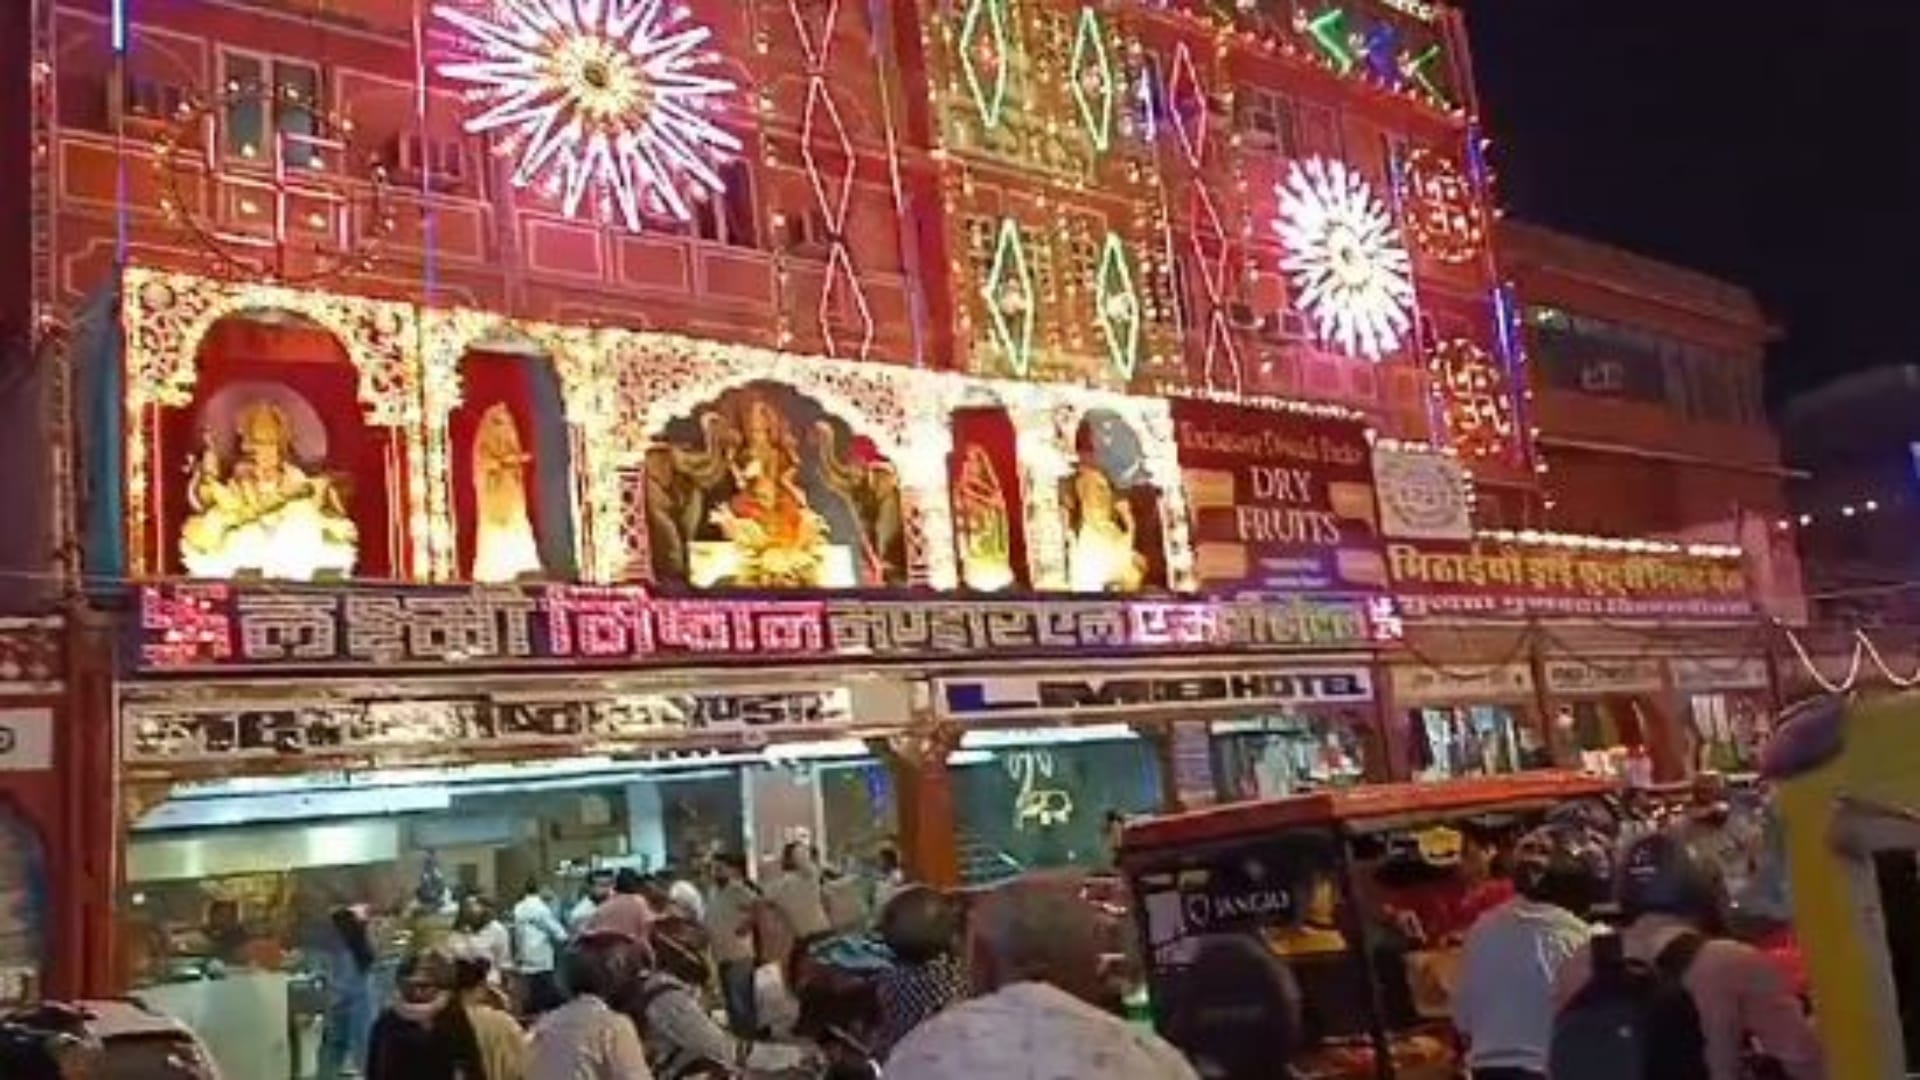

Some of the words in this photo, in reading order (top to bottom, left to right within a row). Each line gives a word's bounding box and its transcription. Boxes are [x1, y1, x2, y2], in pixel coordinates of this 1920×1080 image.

[1250, 465, 1312, 502] DRY
[1235, 504, 1341, 546] FRUITS
[946, 676, 1227, 712] LMB
[1230, 673, 1368, 699] HOTEL
